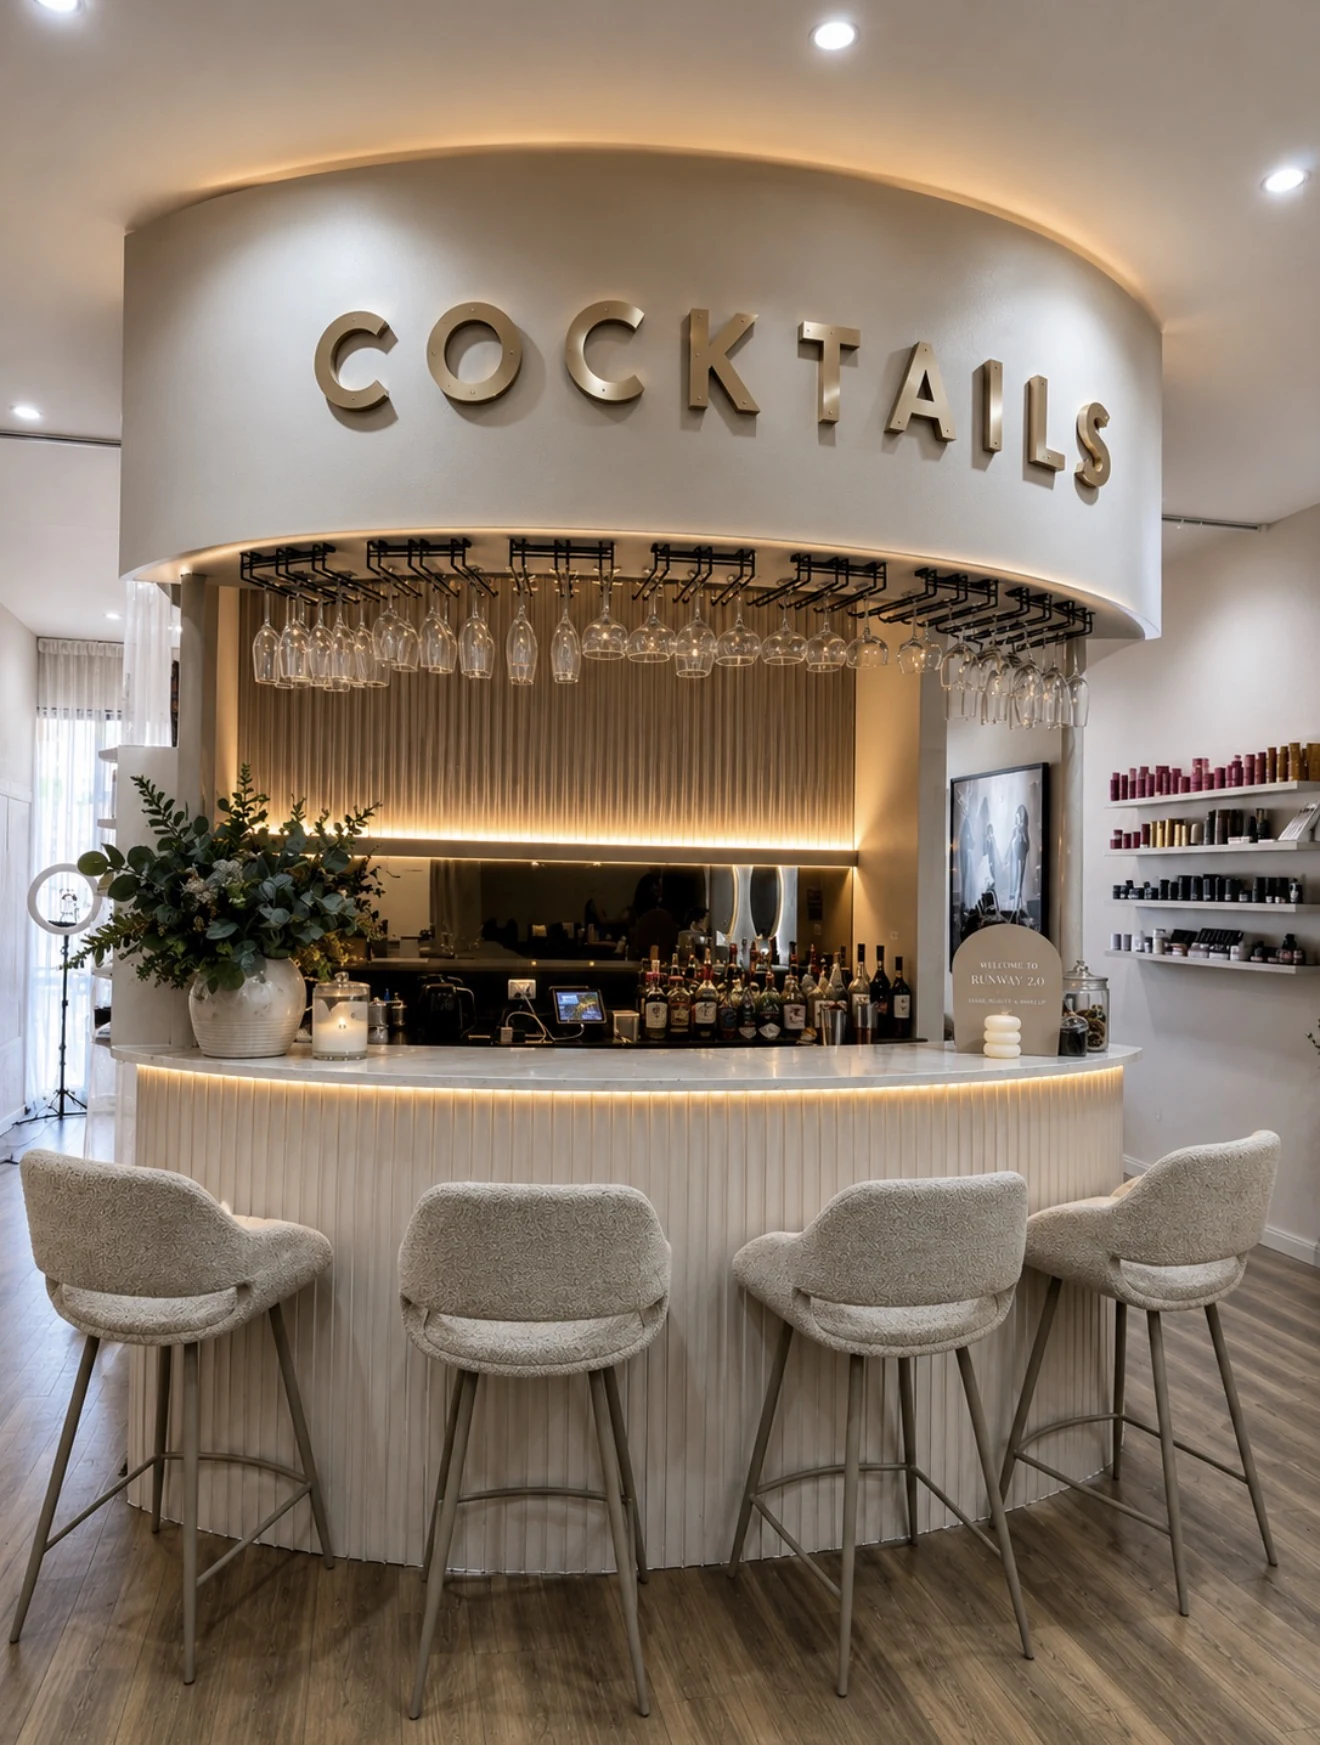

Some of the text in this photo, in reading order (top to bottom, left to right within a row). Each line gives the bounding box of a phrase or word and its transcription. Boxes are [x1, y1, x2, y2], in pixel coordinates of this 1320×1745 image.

[314, 300, 1112, 488] COCKTAILS
[980, 961, 1038, 970] WELCOME TO
[971, 974, 1045, 987] RUNWAY 2.0
